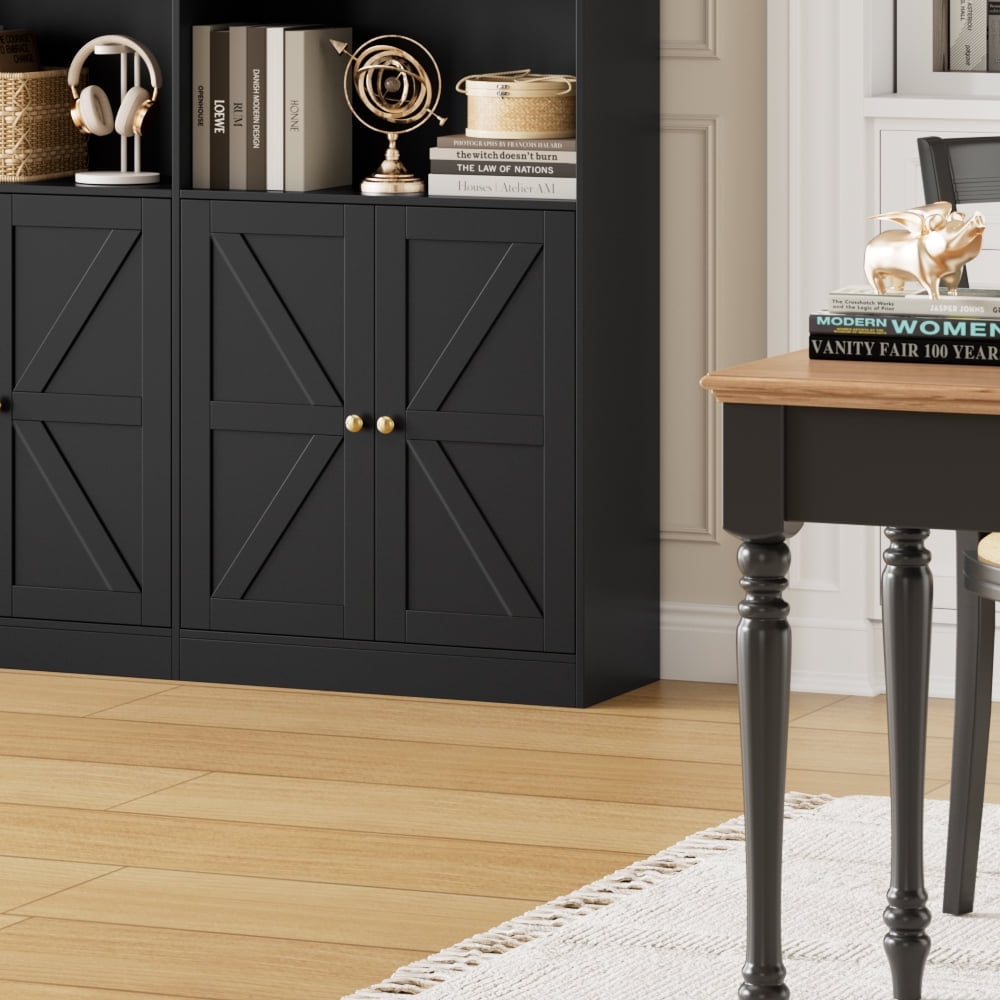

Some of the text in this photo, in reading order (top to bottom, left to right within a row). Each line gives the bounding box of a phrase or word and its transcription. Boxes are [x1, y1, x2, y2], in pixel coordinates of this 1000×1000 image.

[214, 100, 225, 134] LOEWE
[233, 102, 243, 127] RUM
[290, 100, 299, 132] HONNE
[474, 151, 498, 159] witch
[499, 152, 534, 160] doesn't
[536, 153, 557, 161] burn
[457, 164, 475, 172] THE
[515, 166, 553, 174] NATIONS
[458, 180, 492, 191] Houses
[502, 182, 536, 193] Atelier
[960, 305, 984, 313] JOHNS
[817, 316, 887, 327] MODERN
[811, 340, 1000, 360] VANITY FAIR 100 YEAR
